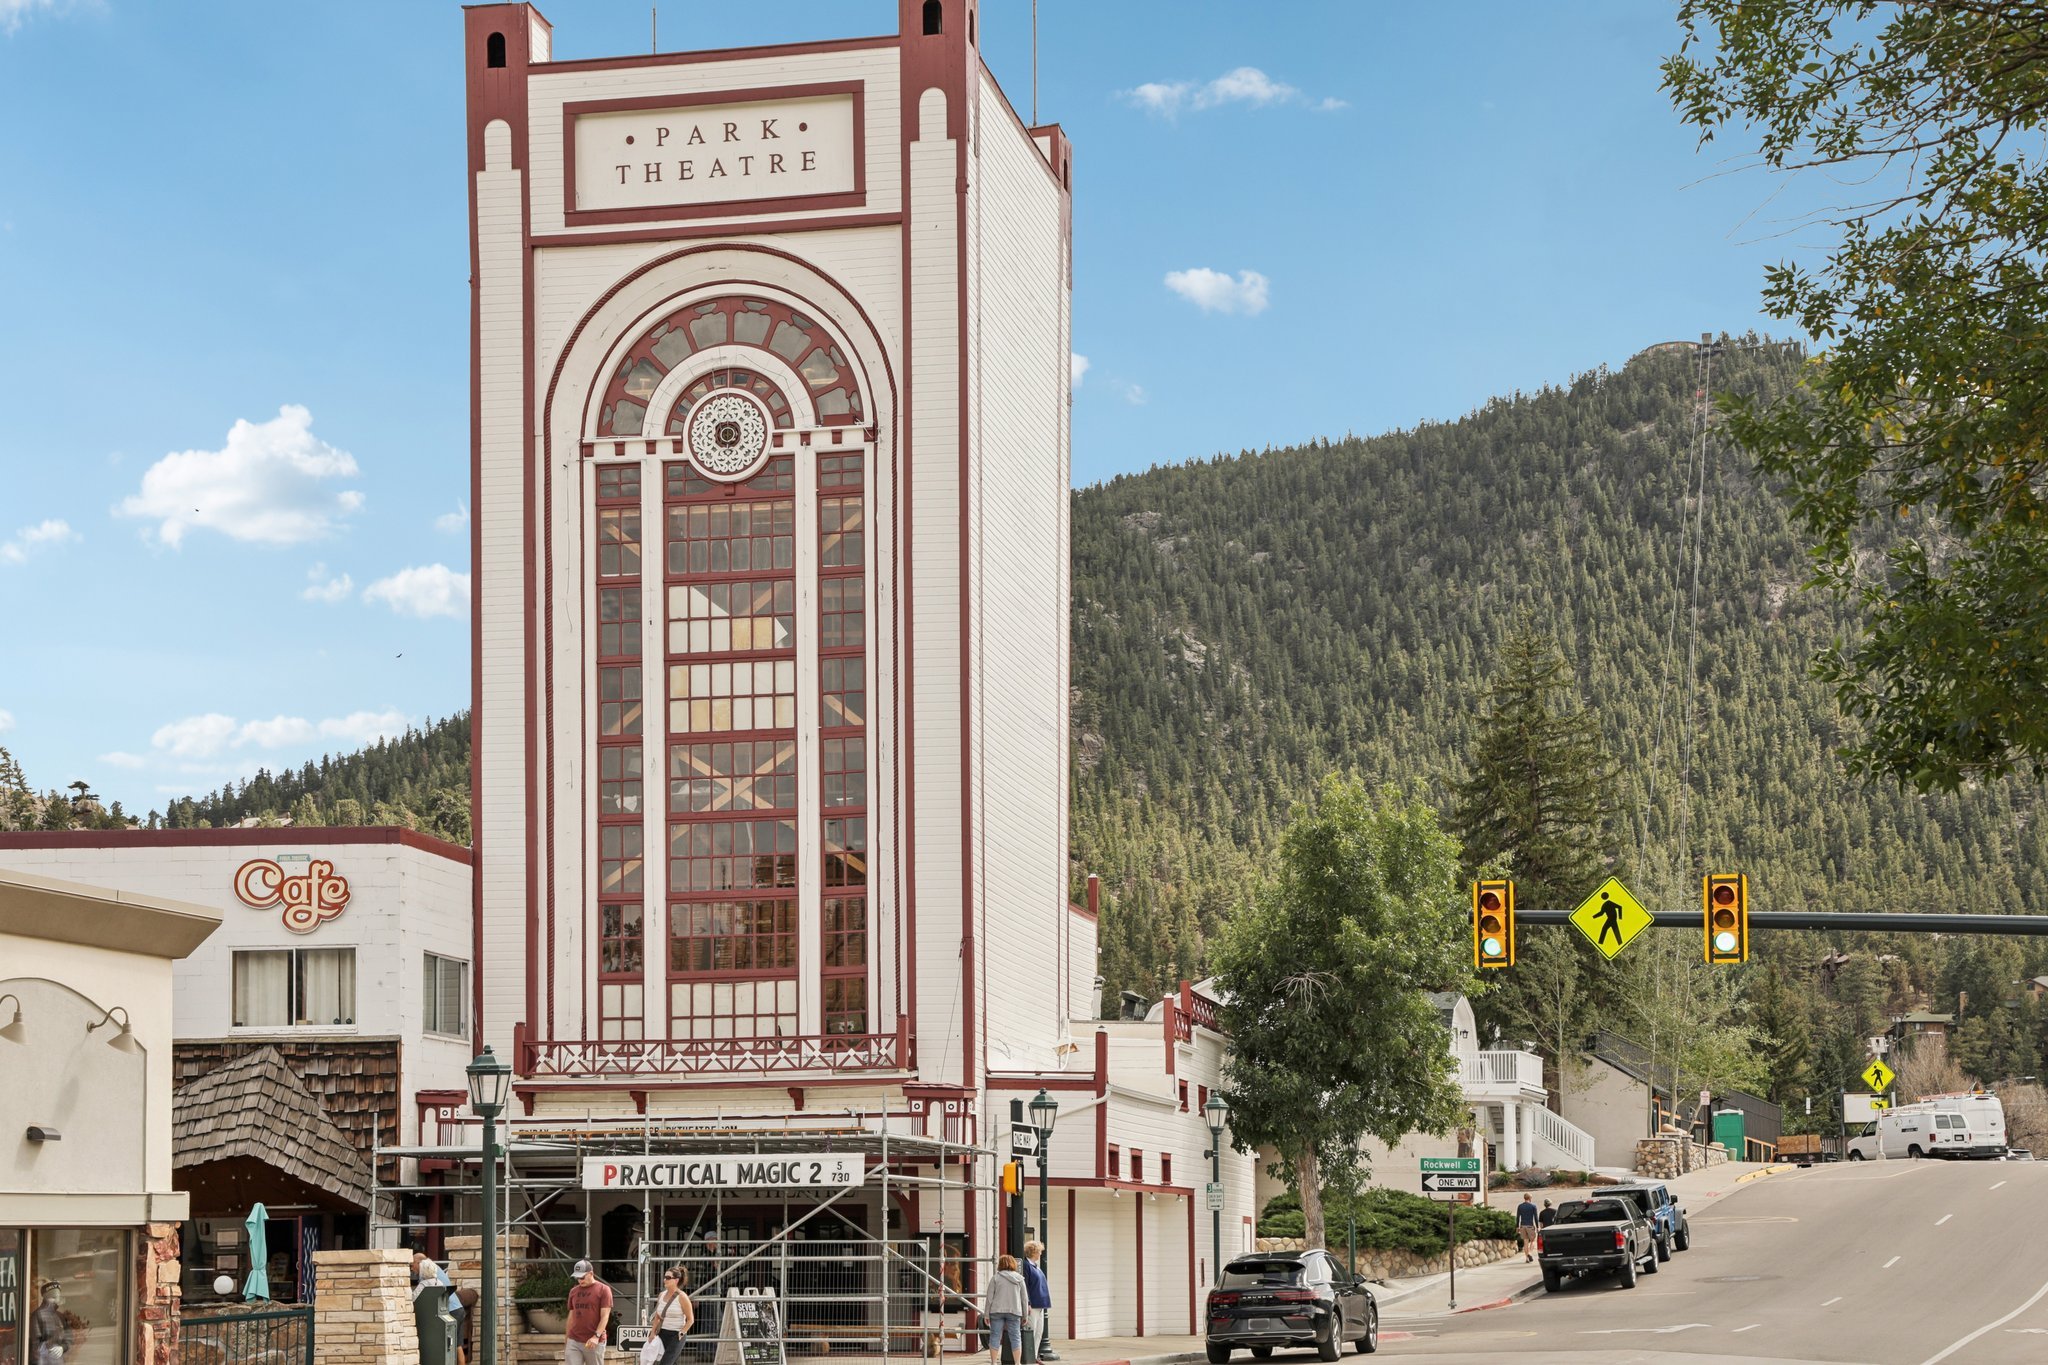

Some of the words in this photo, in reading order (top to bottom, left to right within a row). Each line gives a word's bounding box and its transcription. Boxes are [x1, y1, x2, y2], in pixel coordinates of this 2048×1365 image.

[655, 118, 781, 147] PARK
[615, 150, 817, 185] THEATRE
[234, 859, 351, 934] Cafe
[836, 1161, 843, 1170] 5
[1423, 1160, 1461, 1169] Rockwell
[1467, 1160, 1477, 1169] St
[603, 1163, 728, 1186] PRACTICAL
[737, 1161, 802, 1185] MAGIC
[808, 1162, 822, 1184] 2
[831, 1172, 850, 1182] 730
[1438, 1178, 1454, 1187] ONE
[1457, 1178, 1474, 1187] WAY
[737, 1302, 756, 1311] SEVEN
